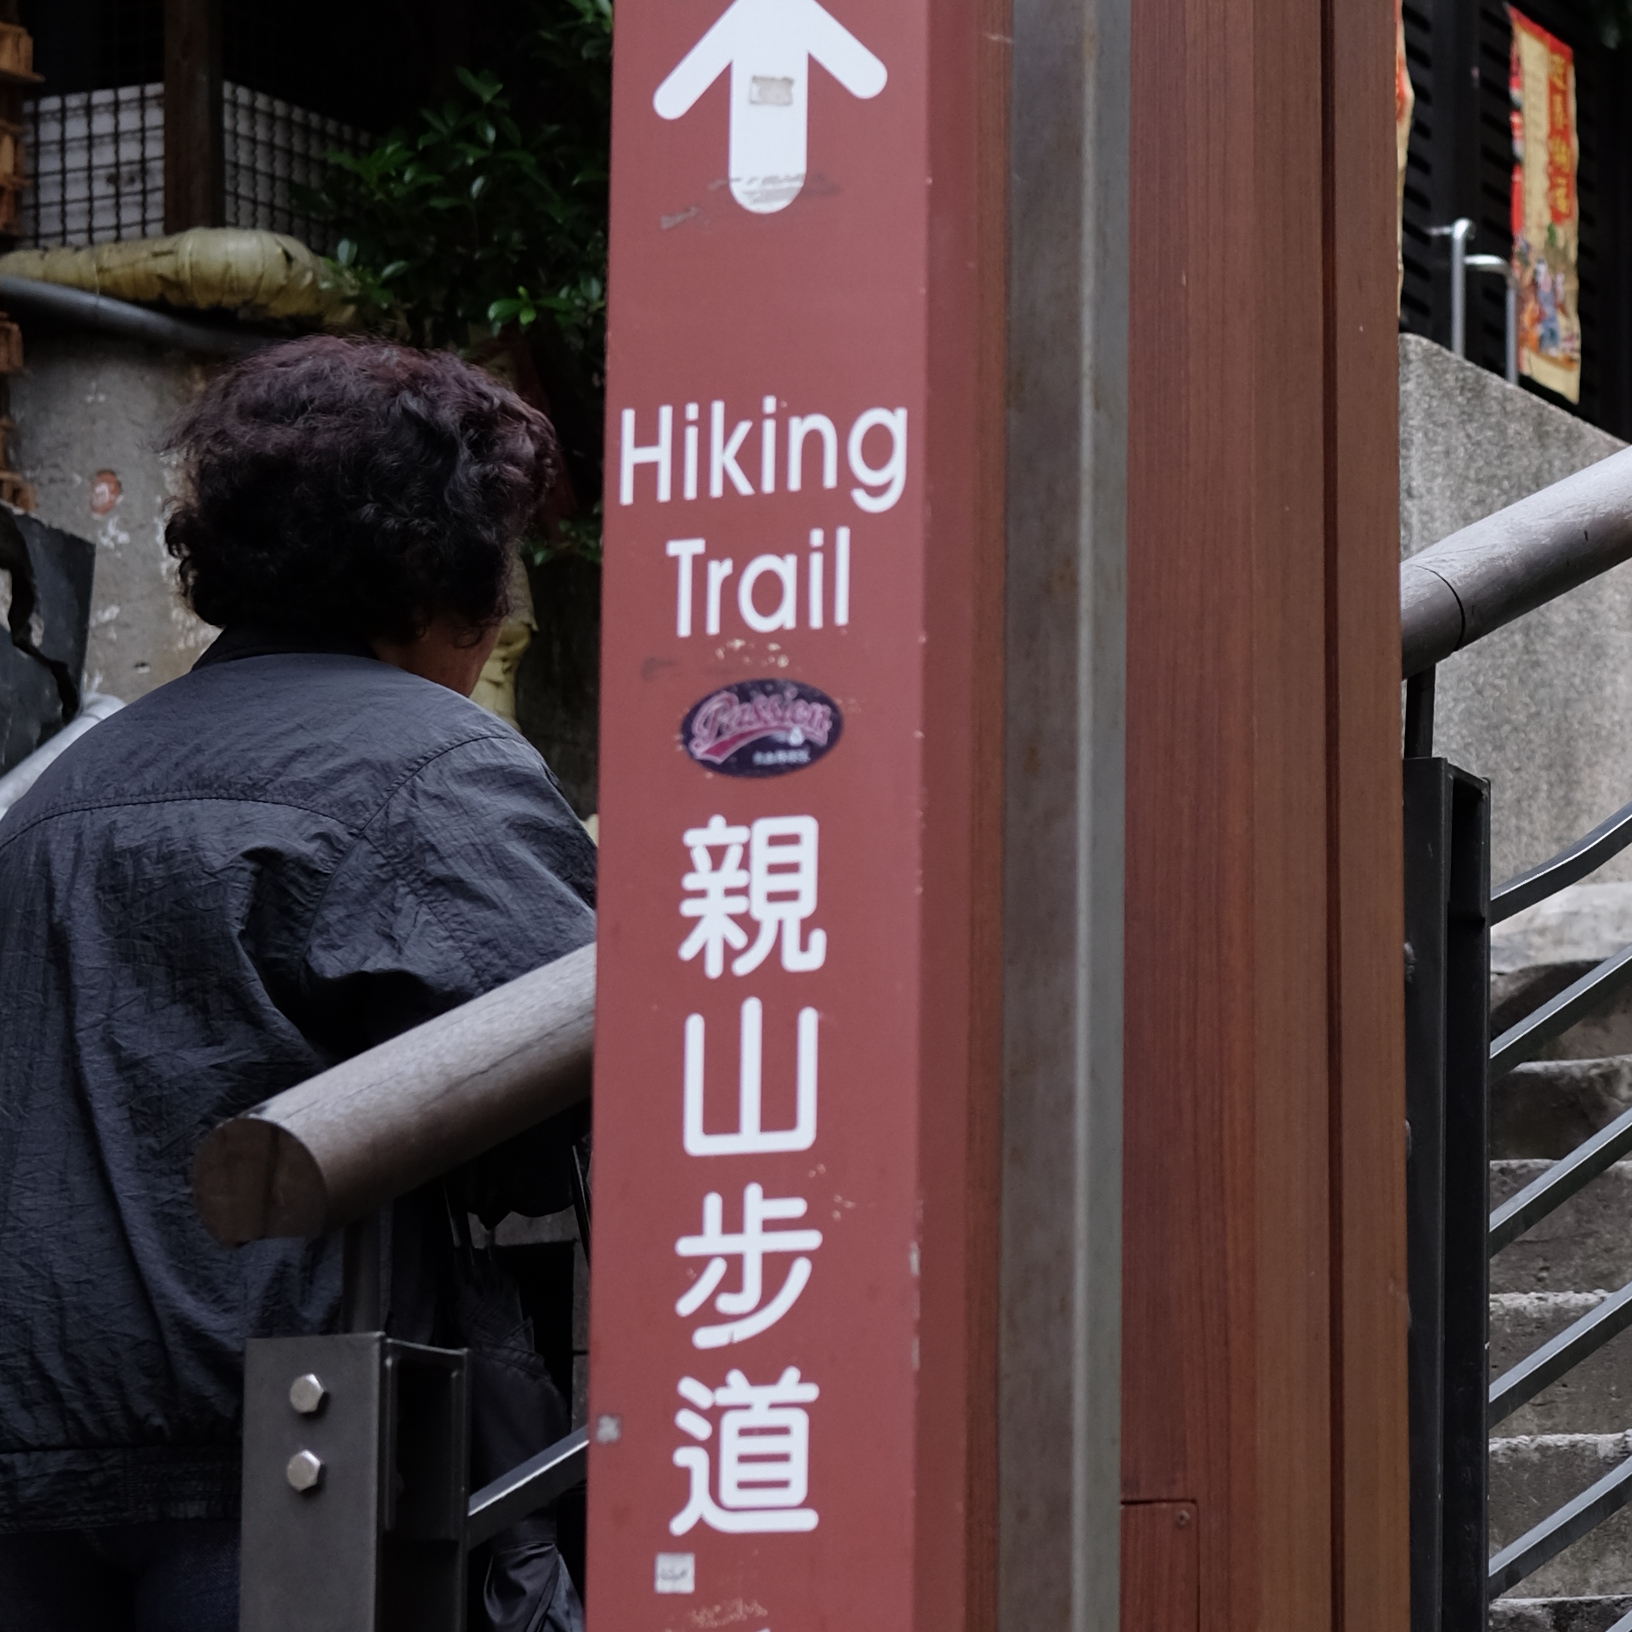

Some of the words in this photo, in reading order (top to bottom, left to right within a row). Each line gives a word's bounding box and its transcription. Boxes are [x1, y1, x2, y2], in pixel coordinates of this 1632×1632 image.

[618, 395, 908, 514] Hiking
[665, 525, 851, 638] Trail
[668, 813, 828, 1536] 親山步道
